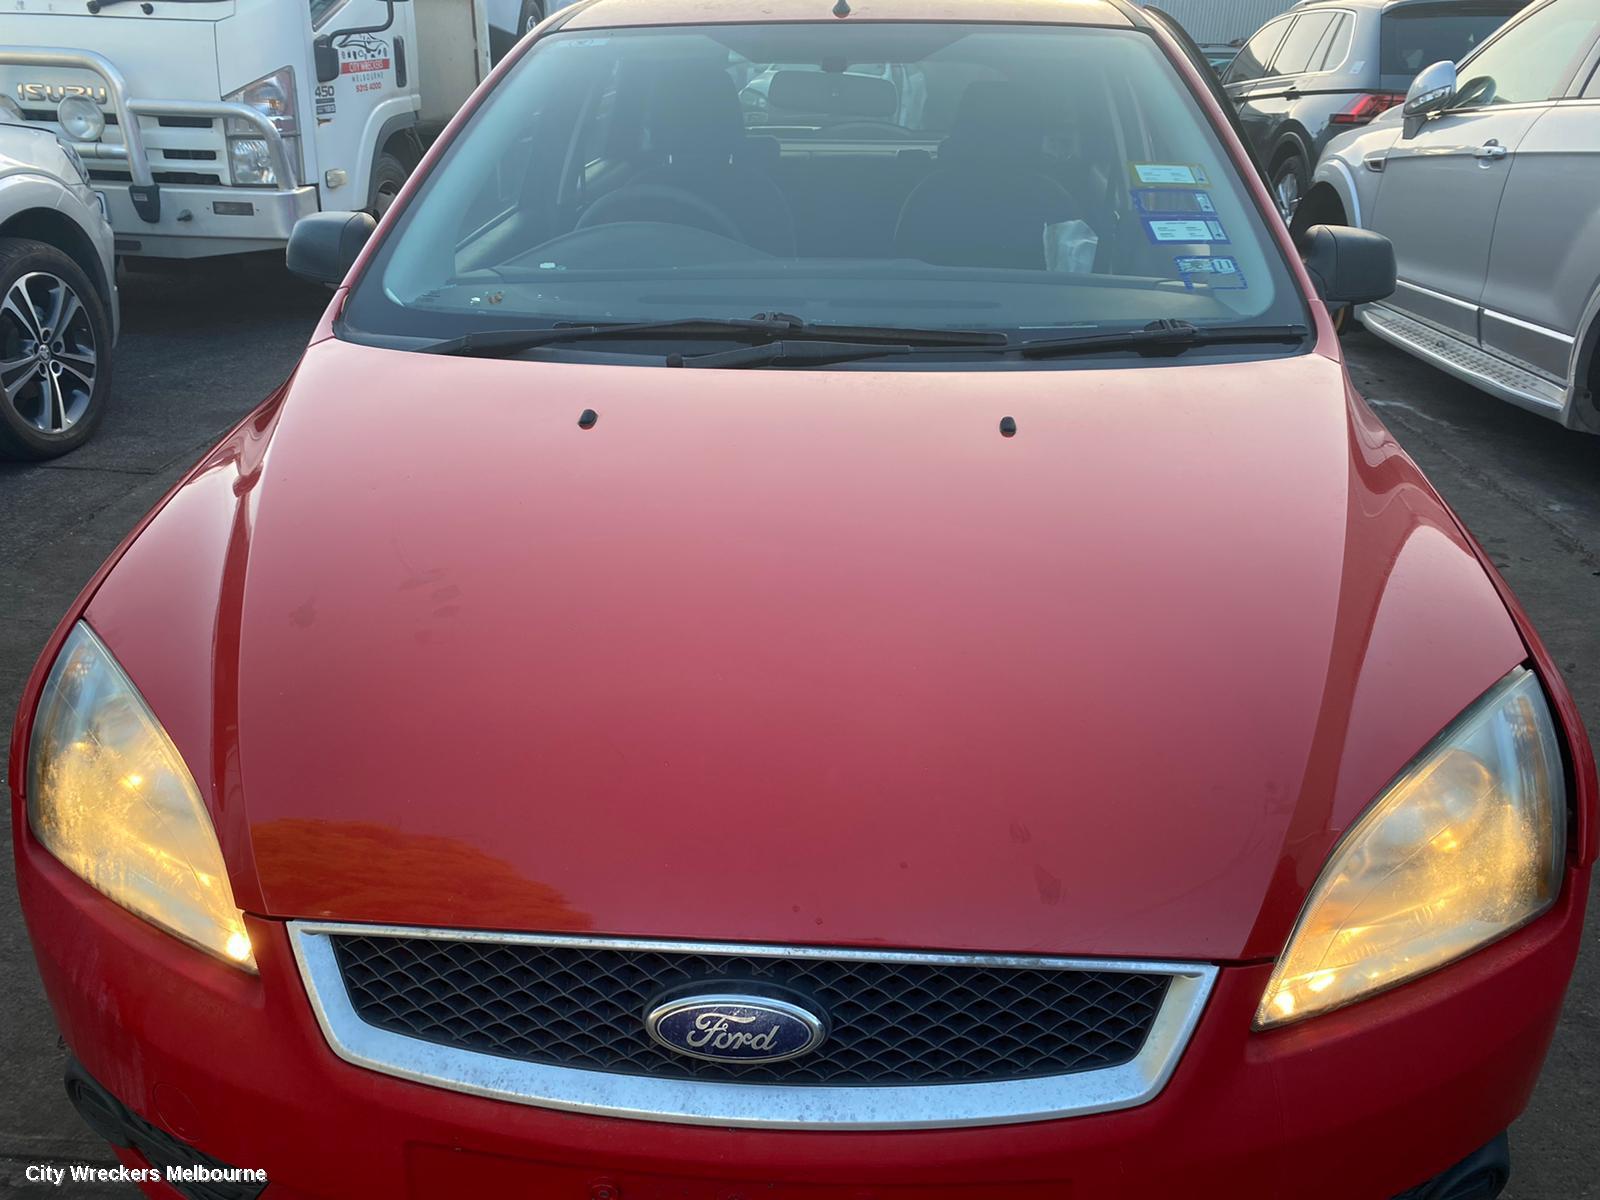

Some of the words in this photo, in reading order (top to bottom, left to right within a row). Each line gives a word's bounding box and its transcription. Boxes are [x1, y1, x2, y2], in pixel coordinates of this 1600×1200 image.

[349, 62, 359, 72] CITY
[17, 83, 107, 104] ISUZU
[315, 85, 335, 98] 450
[686, 1012, 780, 1050] Ford
